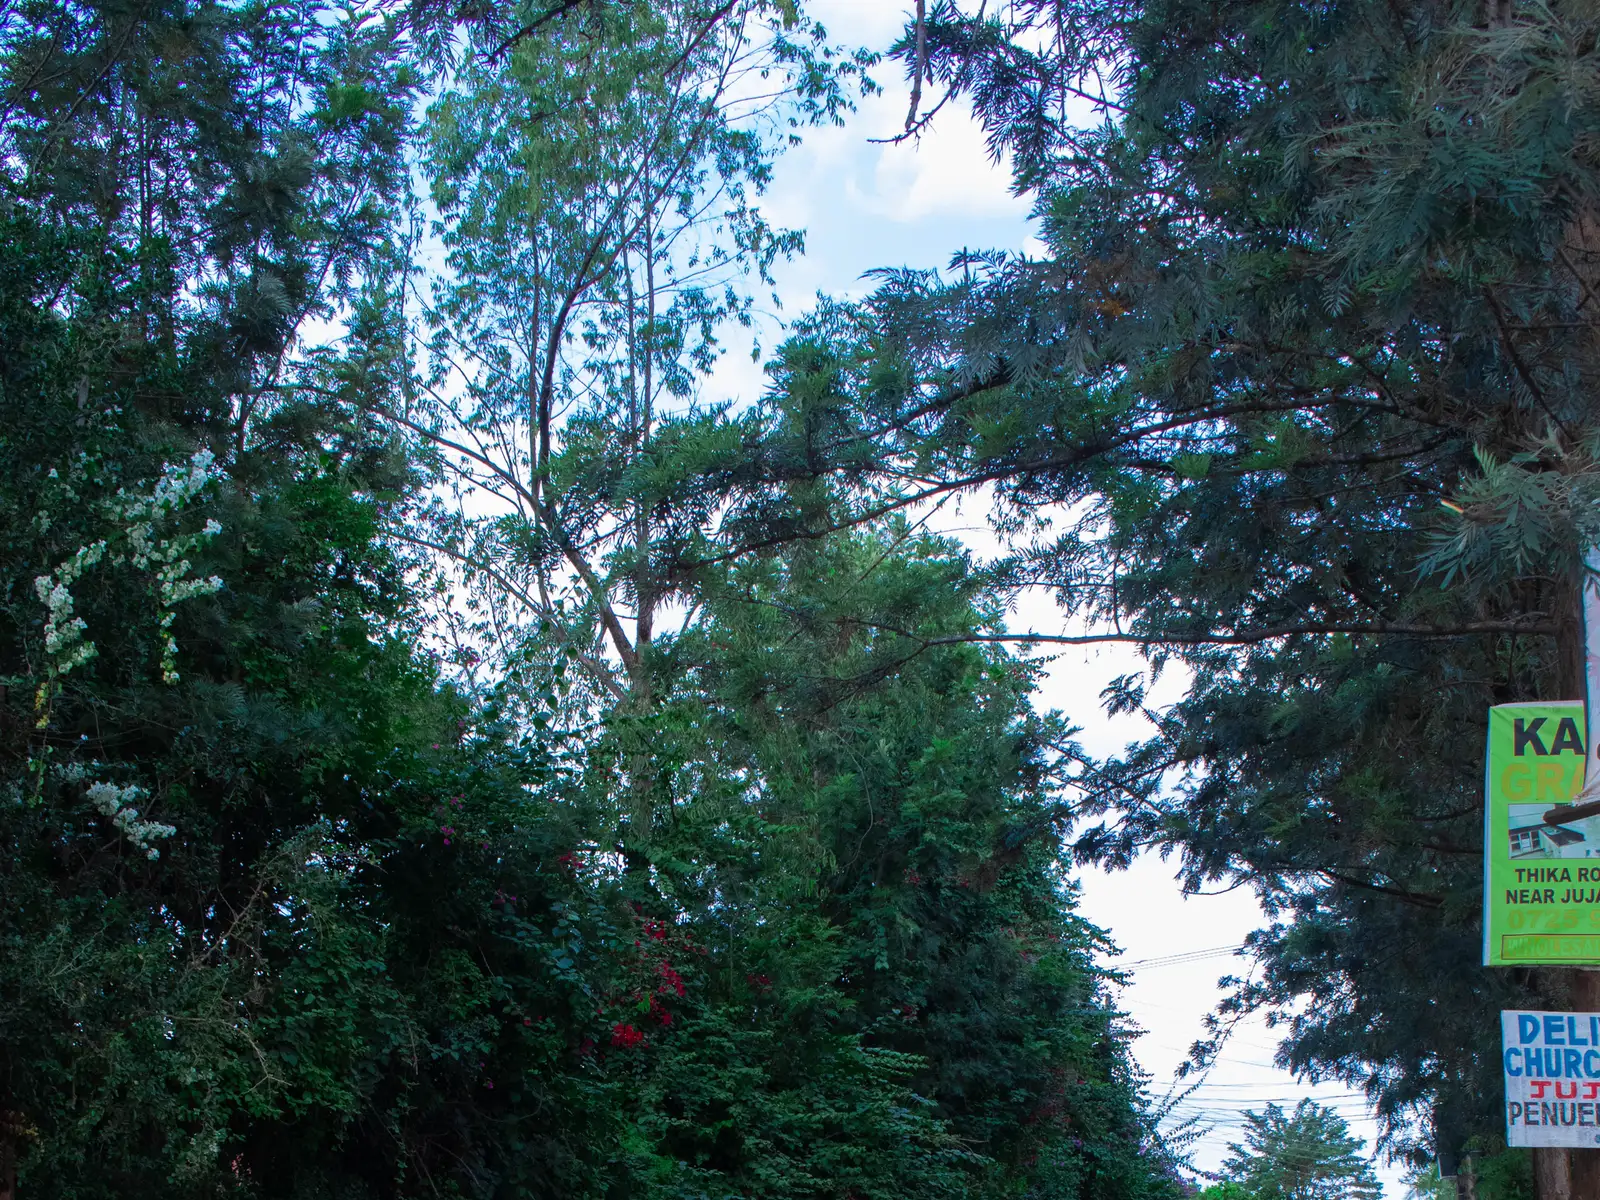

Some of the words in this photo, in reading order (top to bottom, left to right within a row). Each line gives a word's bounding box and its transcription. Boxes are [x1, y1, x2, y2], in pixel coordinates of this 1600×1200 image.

[1515, 867, 1571, 883] THIKA
[1506, 889, 1555, 904] NEAR
[1508, 909, 1579, 929] 0725
[1504, 1047, 1600, 1078] CHURC
